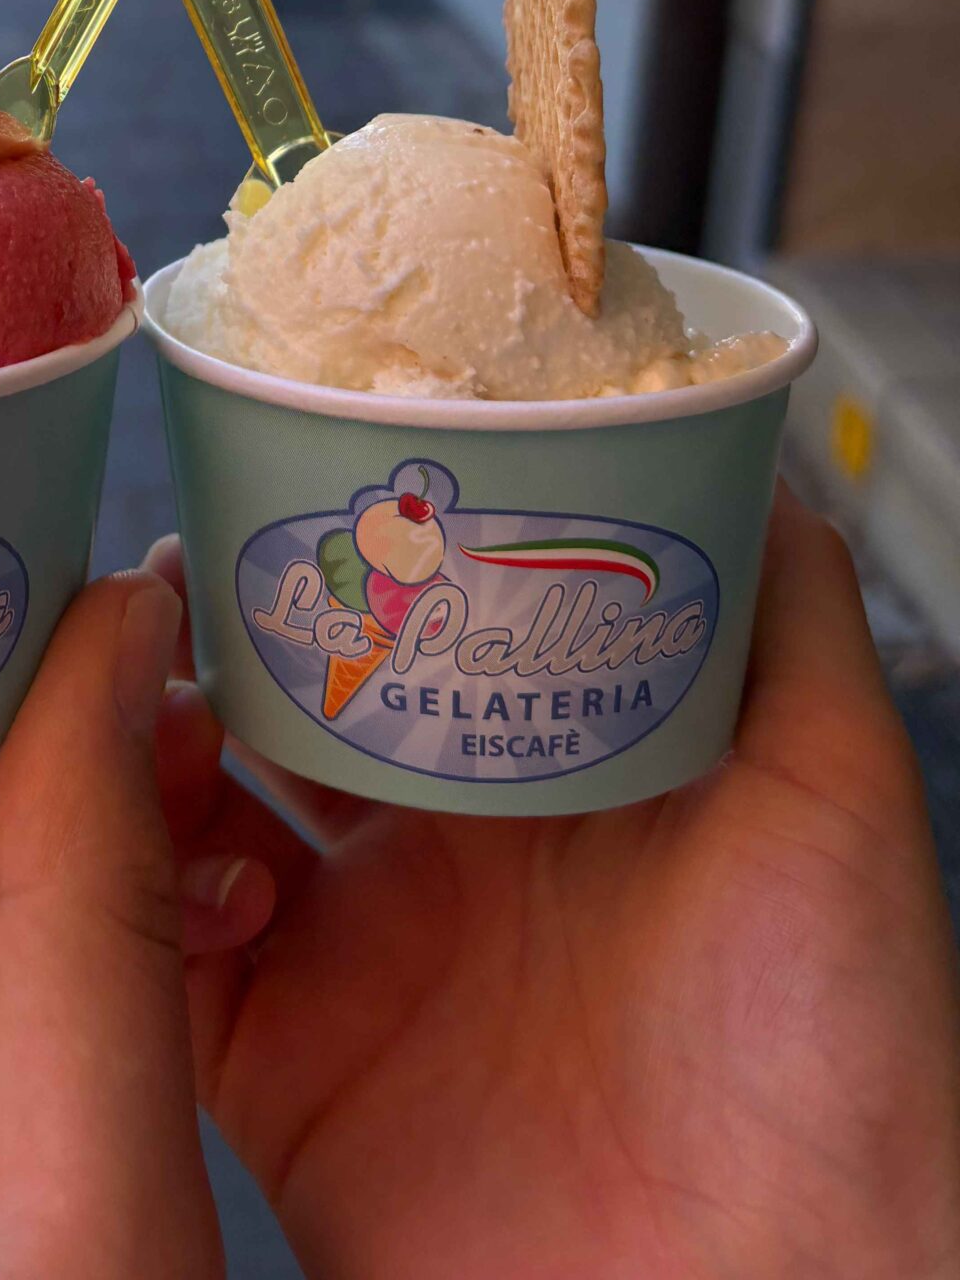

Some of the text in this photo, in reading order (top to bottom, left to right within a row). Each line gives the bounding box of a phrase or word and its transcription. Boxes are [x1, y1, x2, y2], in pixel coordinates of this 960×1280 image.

[253, 559, 707, 677] La Pallina
[379, 680, 653, 721] GELATERIA
[460, 728, 581, 757] EISCAFÈ
